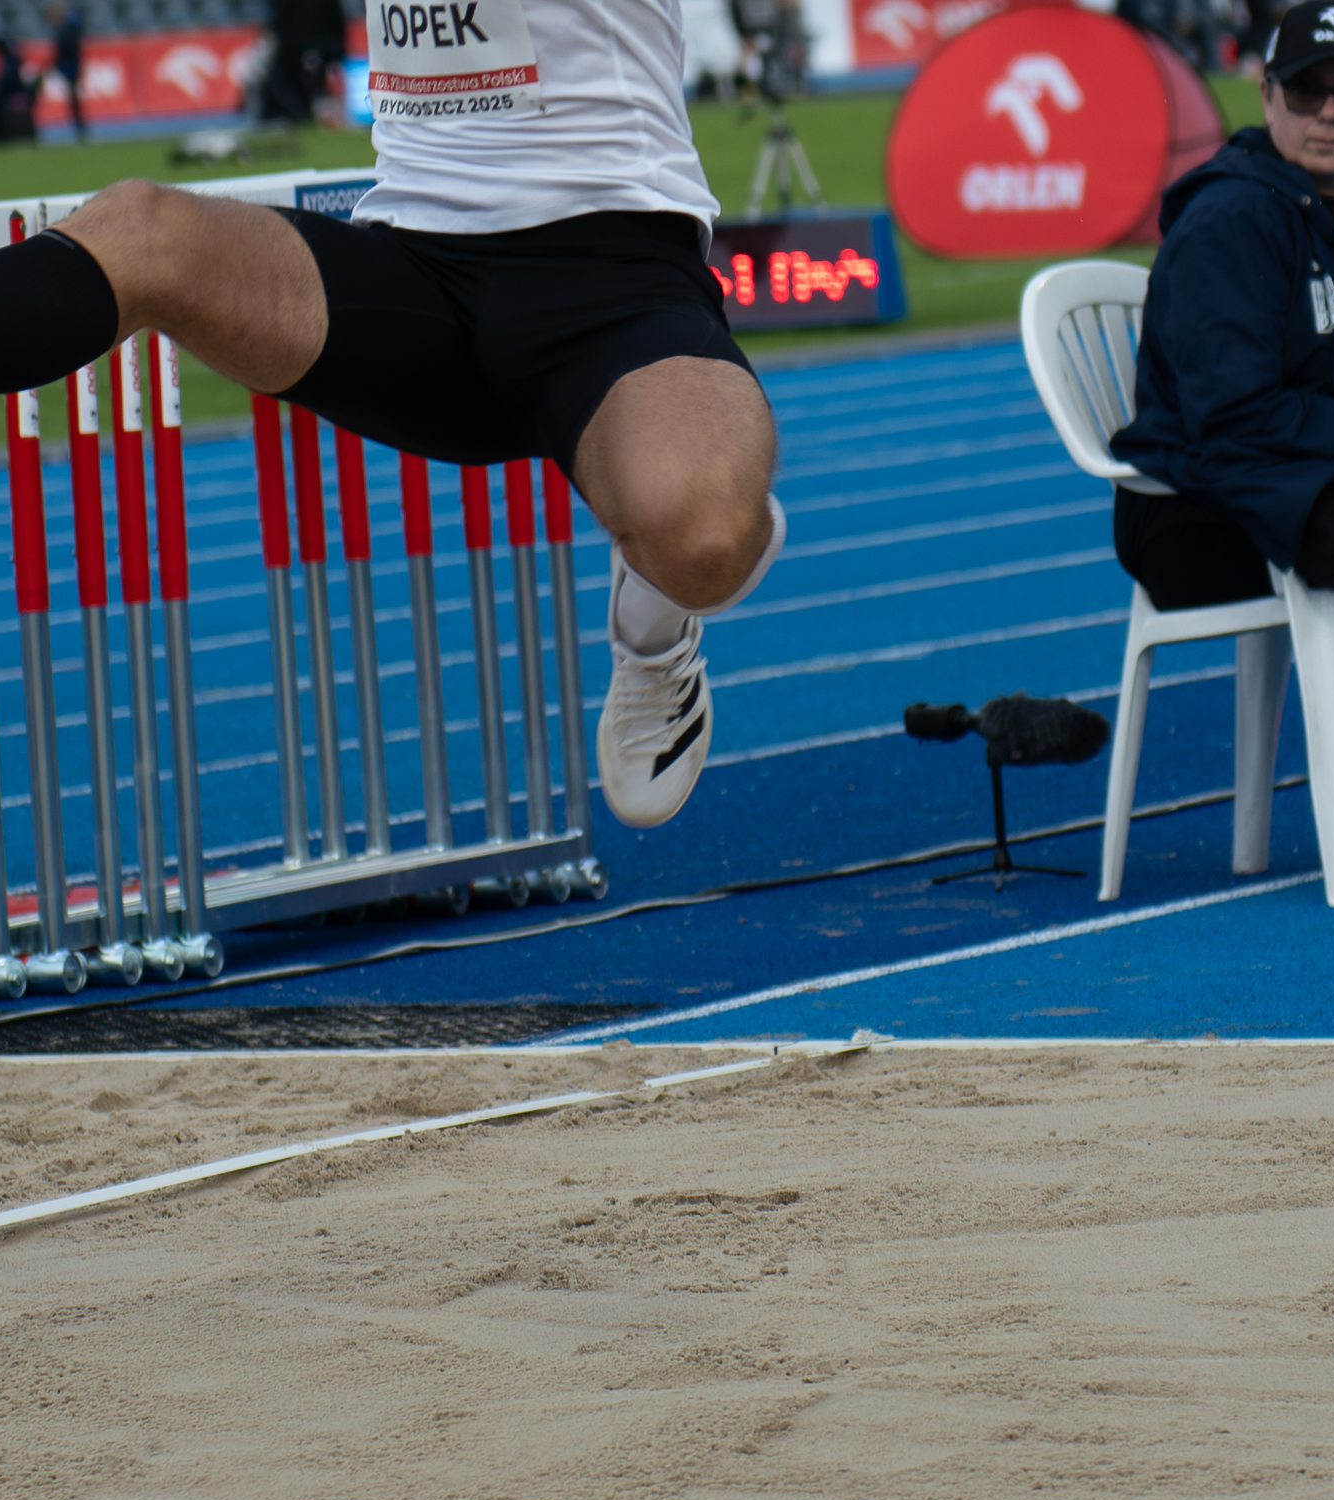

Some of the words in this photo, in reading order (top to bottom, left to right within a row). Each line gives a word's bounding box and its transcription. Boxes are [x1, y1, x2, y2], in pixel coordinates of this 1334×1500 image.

[381, 0, 490, 49] JOPEK
[481, 67, 527, 89] Polski
[468, 94, 515, 113] 2025
[960, 163, 1085, 212] ORLEN
